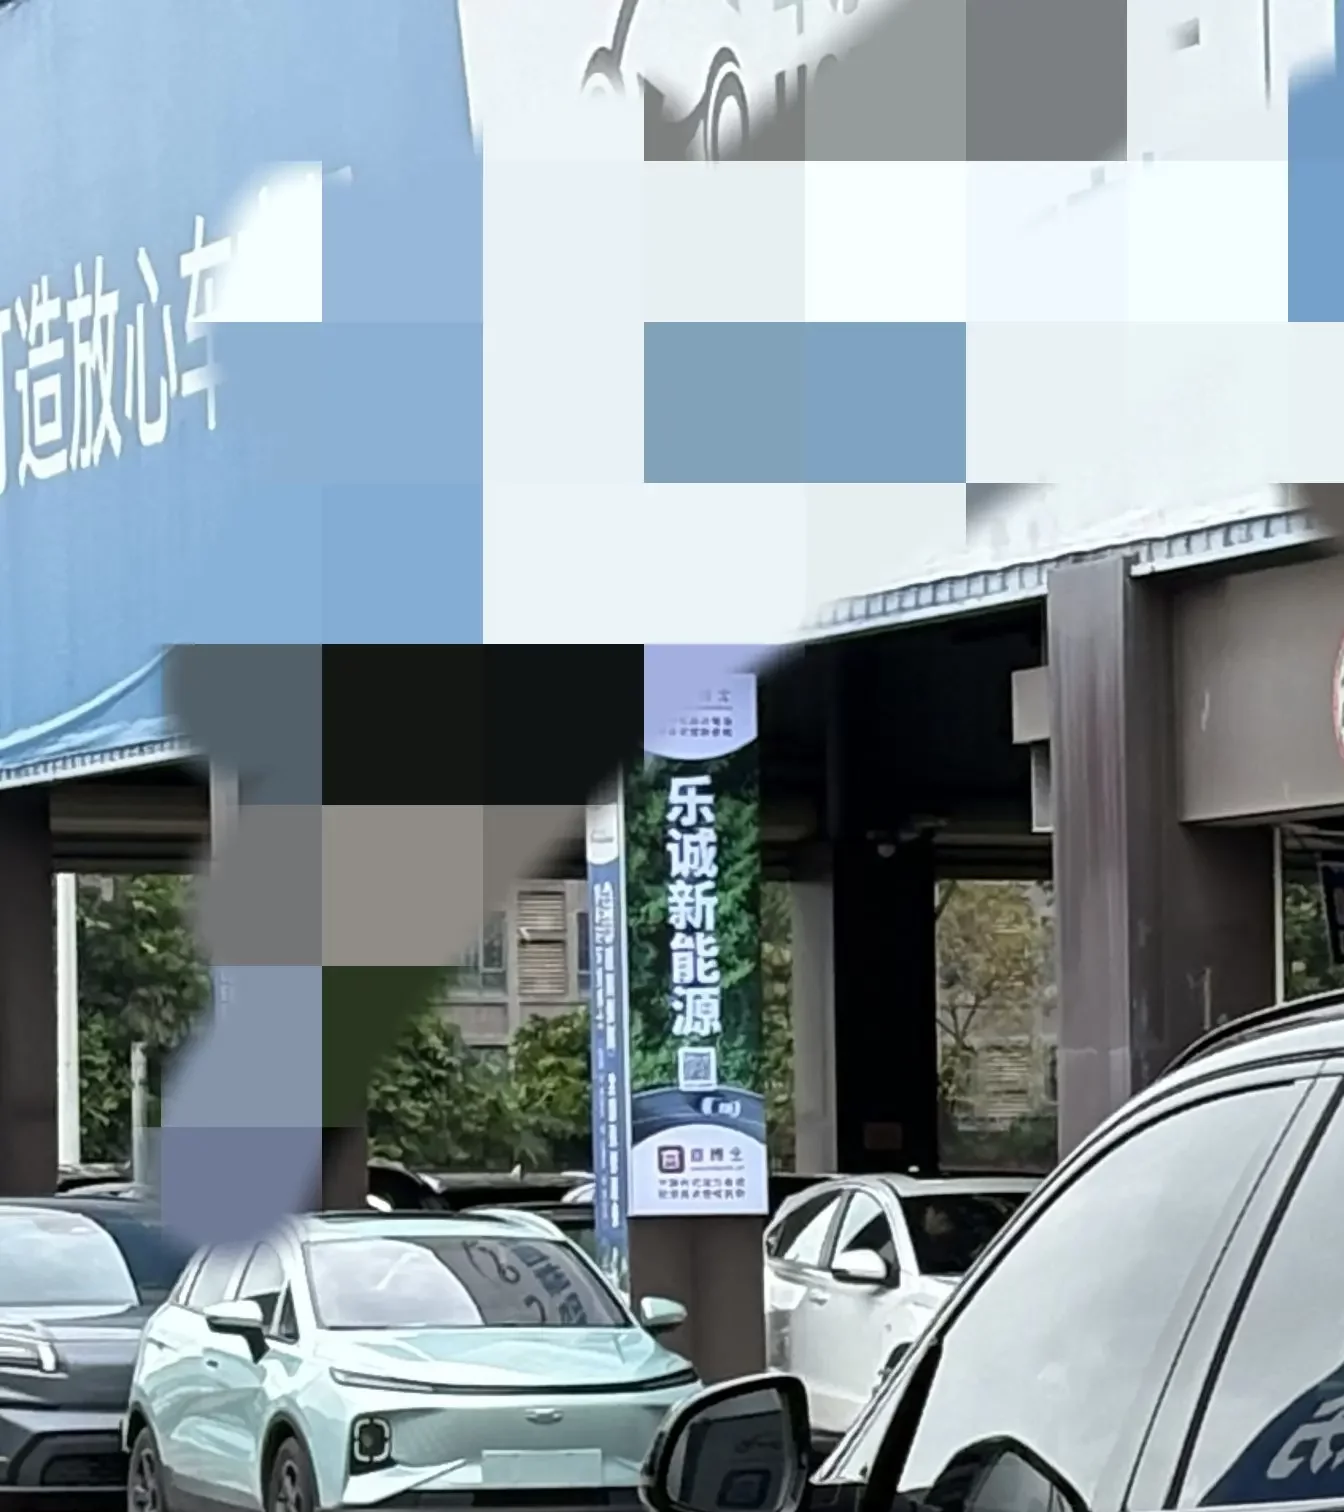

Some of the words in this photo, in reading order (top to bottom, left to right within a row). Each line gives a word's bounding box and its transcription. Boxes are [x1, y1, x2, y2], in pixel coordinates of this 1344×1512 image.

[666, 774, 722, 1039] 乐诚新能源
